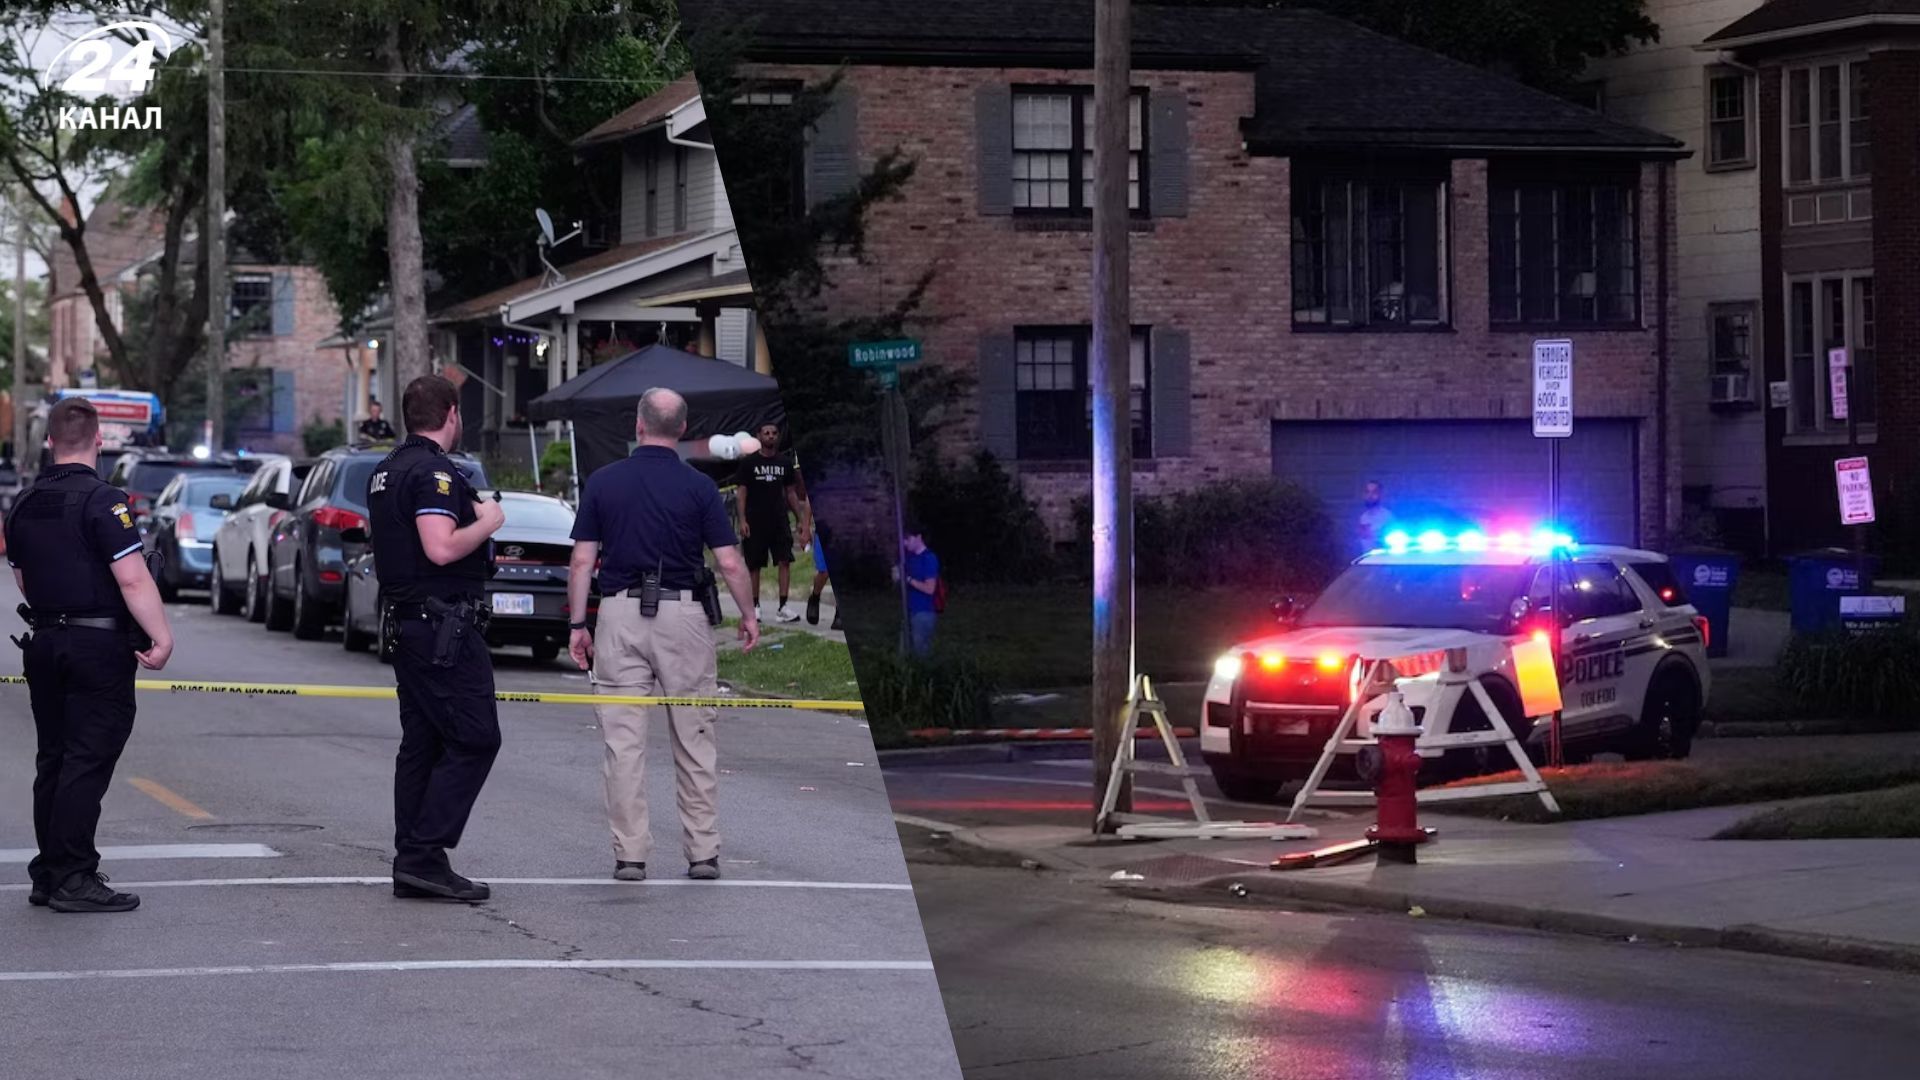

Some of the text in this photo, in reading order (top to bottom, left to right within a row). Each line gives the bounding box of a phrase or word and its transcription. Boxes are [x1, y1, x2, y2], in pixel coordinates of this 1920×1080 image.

[855, 345, 915, 362] Robinwood
[1537, 346, 1568, 363] THROUGH
[1539, 365, 1568, 380] VEHICLES
[1538, 392, 1557, 408] 6000
[1536, 411, 1569, 426] PROHIBITED
[754, 465, 785, 476] AMIRI
[1842, 482, 1869, 493] PARKING
[1562, 650, 1625, 685] POLICE
